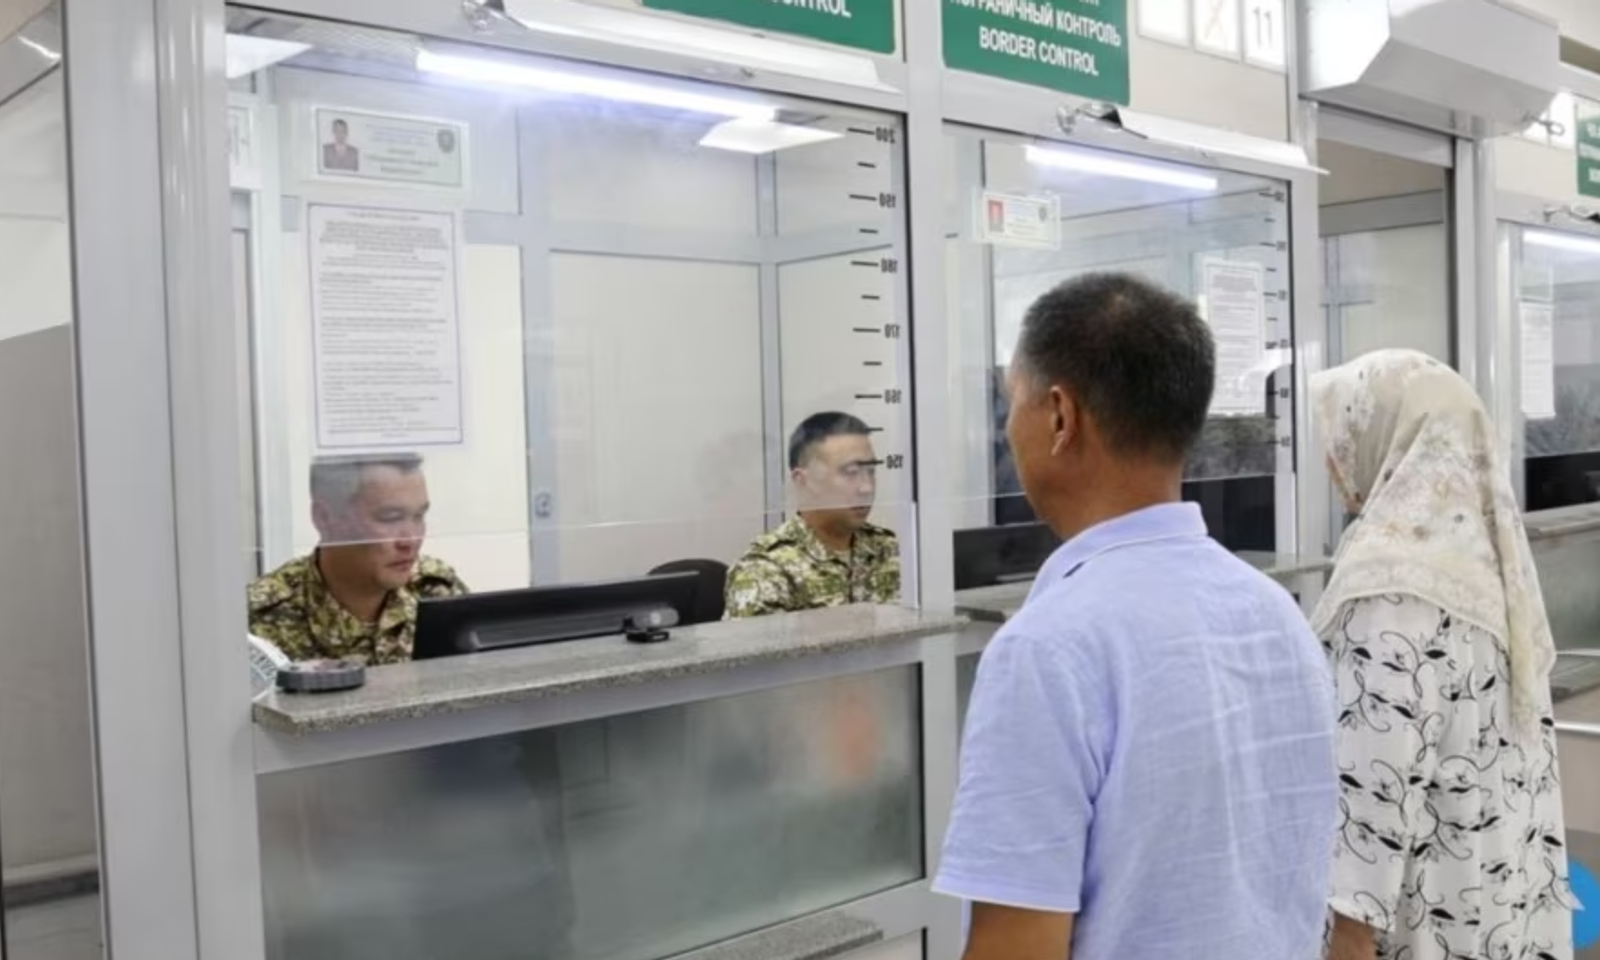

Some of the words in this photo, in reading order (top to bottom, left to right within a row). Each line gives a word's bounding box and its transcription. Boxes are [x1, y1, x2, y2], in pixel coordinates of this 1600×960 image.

[950, 0, 1053, 30] РАНИЧНЫЙ
[1056, 9, 1121, 47] КОНТРОЛЬ
[1251, 6, 1272, 49] 11
[979, 26, 1036, 61] BORDER
[1038, 41, 1099, 76] CONTROL
